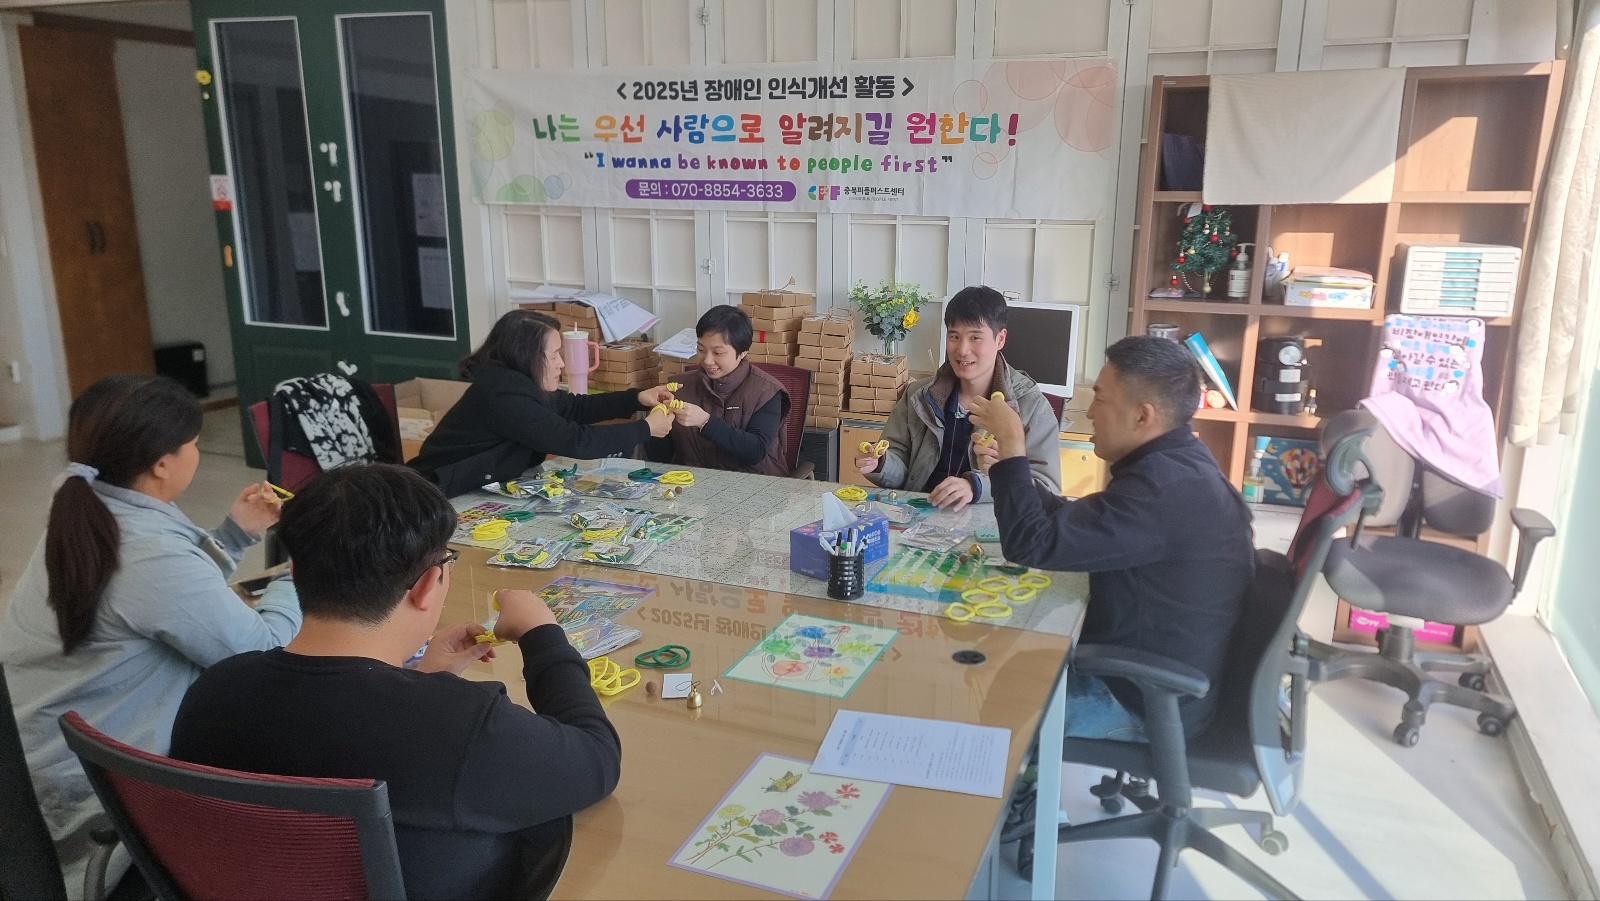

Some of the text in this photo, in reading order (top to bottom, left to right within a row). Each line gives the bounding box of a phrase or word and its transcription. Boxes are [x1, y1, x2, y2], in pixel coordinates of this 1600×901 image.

[632, 80, 699, 102] 2025년
[704, 78, 762, 101] 장애인
[767, 76, 848, 100] 인식개선
[853, 75, 896, 99] 활동
[532, 112, 1019, 147] 나는 우선 사람으로 알려지길 원한다!
[611, 156, 672, 169] wanna
[677, 154, 701, 170] be
[706, 155, 769, 170] known
[777, 156, 801, 171] to
[807, 155, 873, 174] people
[638, 181, 662, 197] 문의
[671, 182, 784, 198] 070-8854-3633
